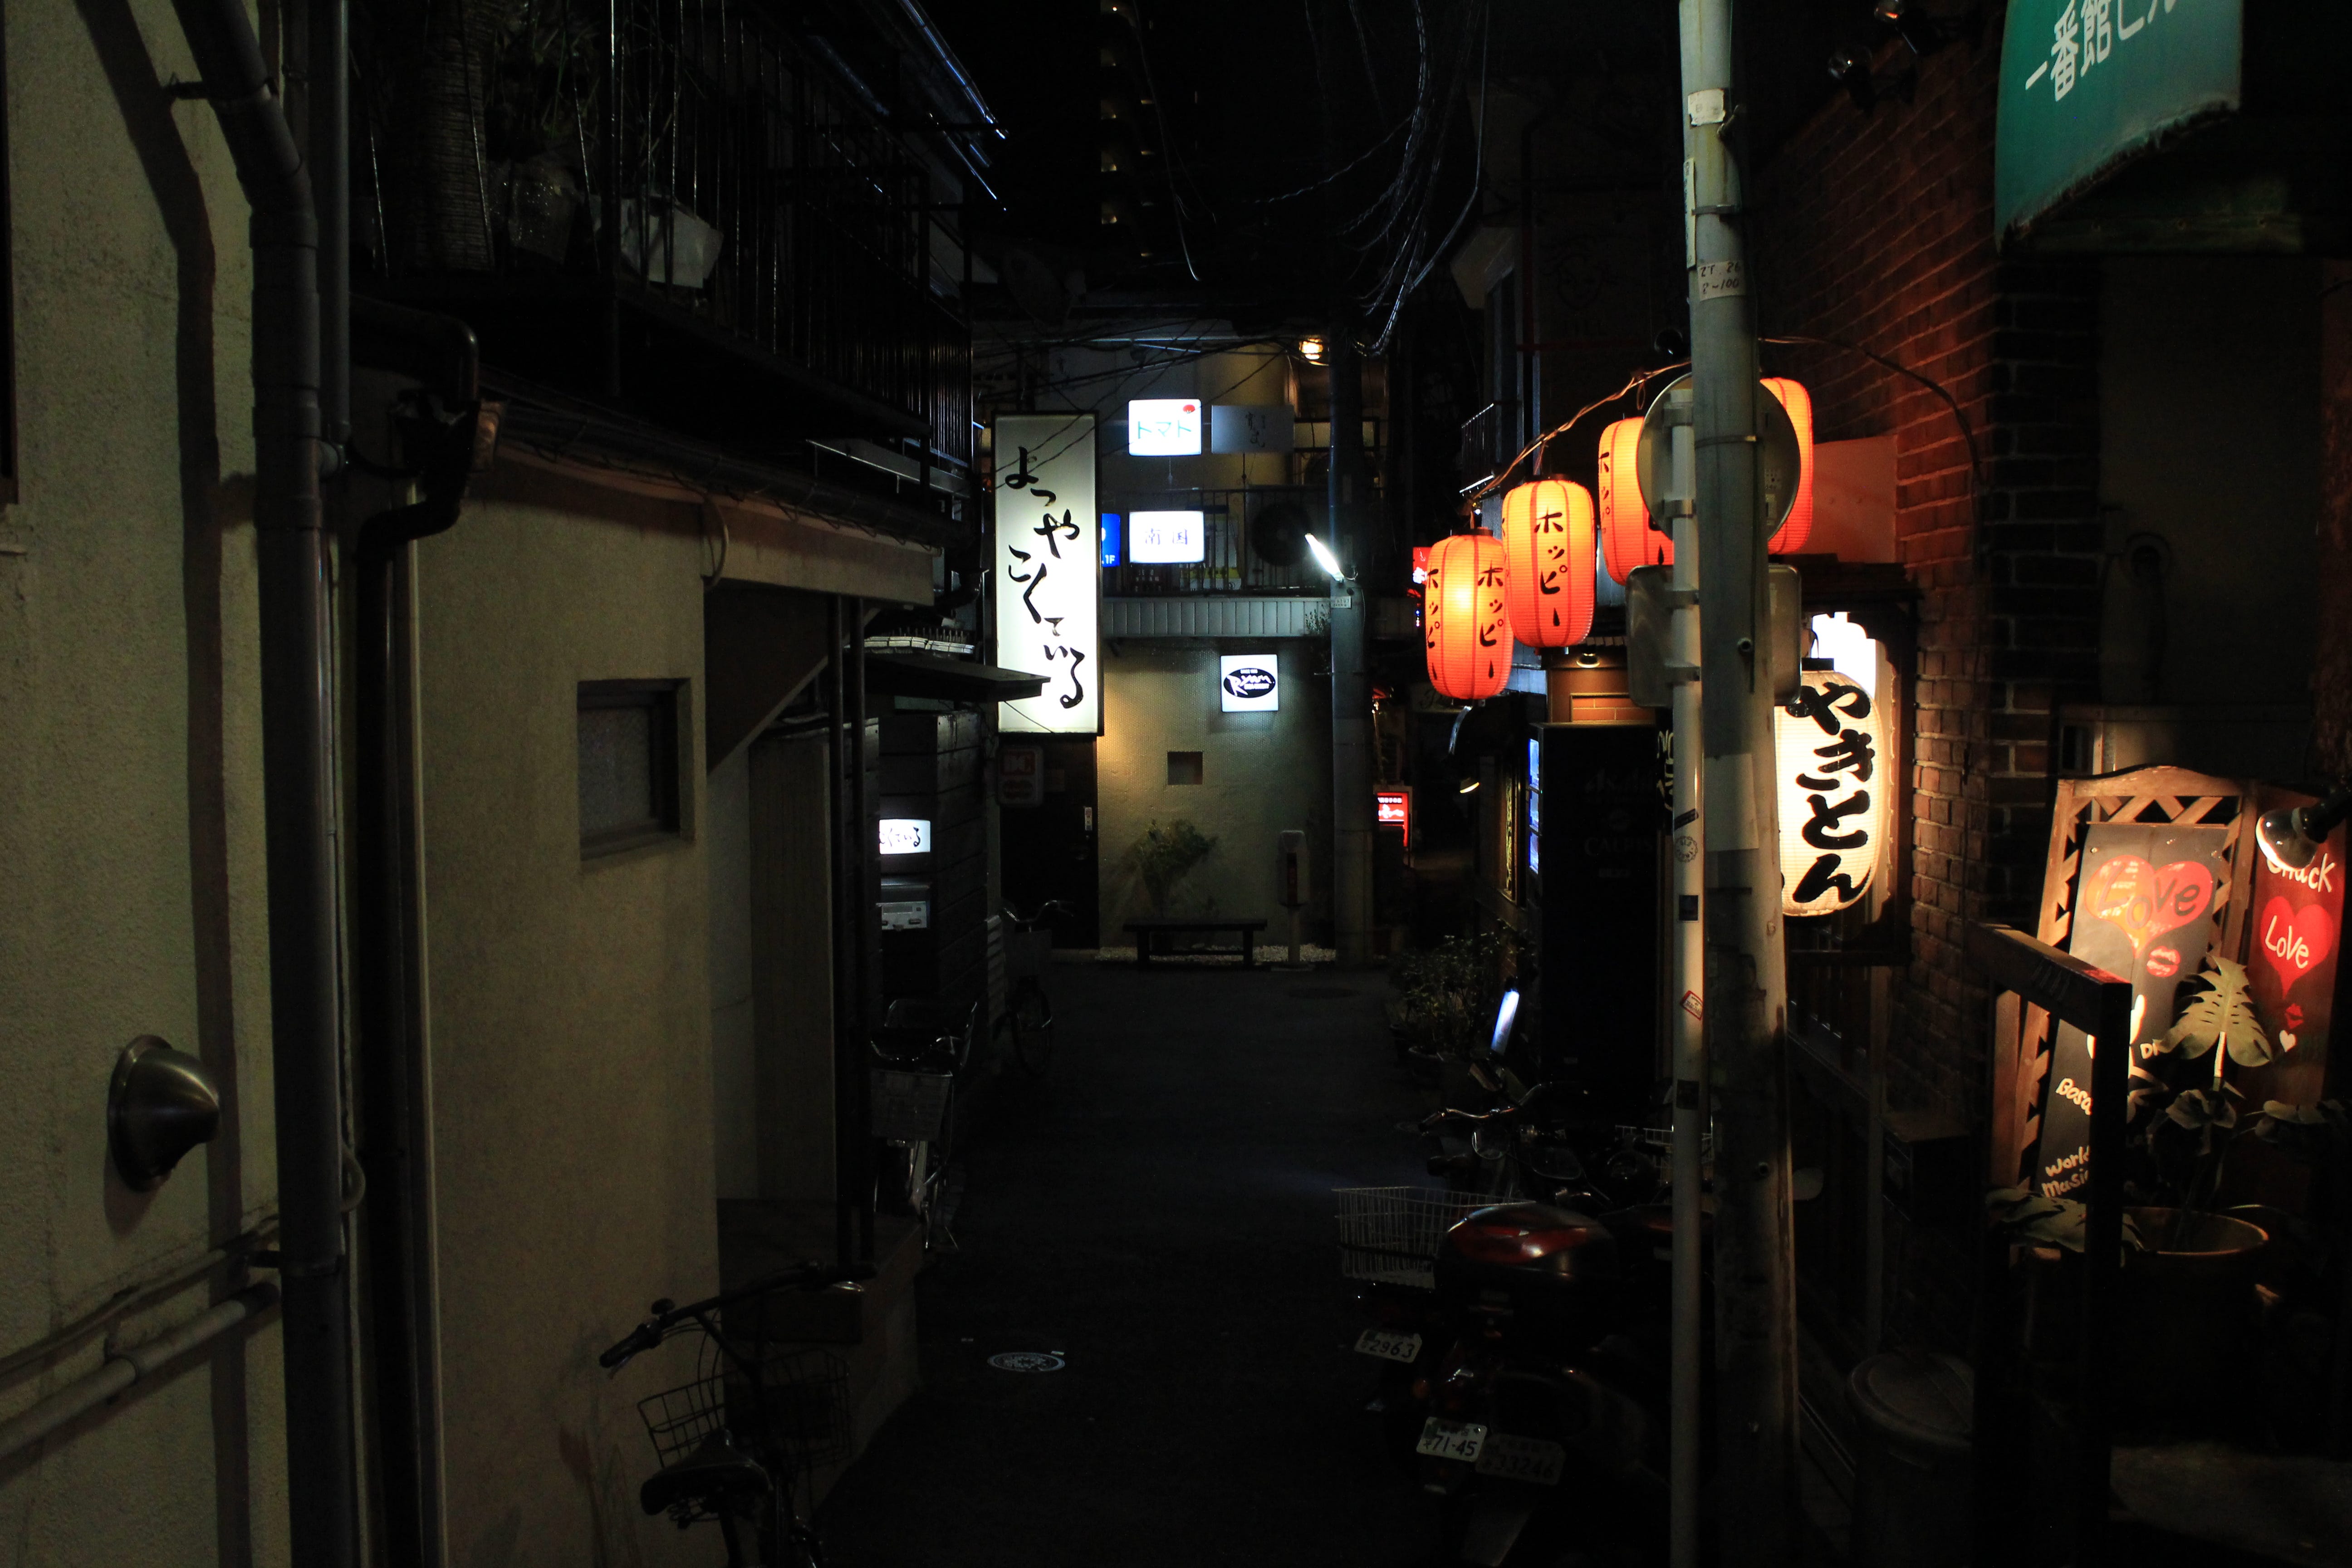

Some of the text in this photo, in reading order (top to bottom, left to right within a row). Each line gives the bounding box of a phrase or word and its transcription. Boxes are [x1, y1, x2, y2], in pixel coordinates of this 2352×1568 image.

[2025, 0, 2177, 102] 一番館
[1137, 420, 1192, 439] トマト
[1427, 562, 1440, 680] ホッピー
[1478, 561, 1504, 679] ホッピー
[1534, 507, 1568, 627] ホッピー
[1785, 681, 1876, 903] やきとん
[2097, 862, 2201, 930] Love
[2265, 915, 2309, 969] Love
